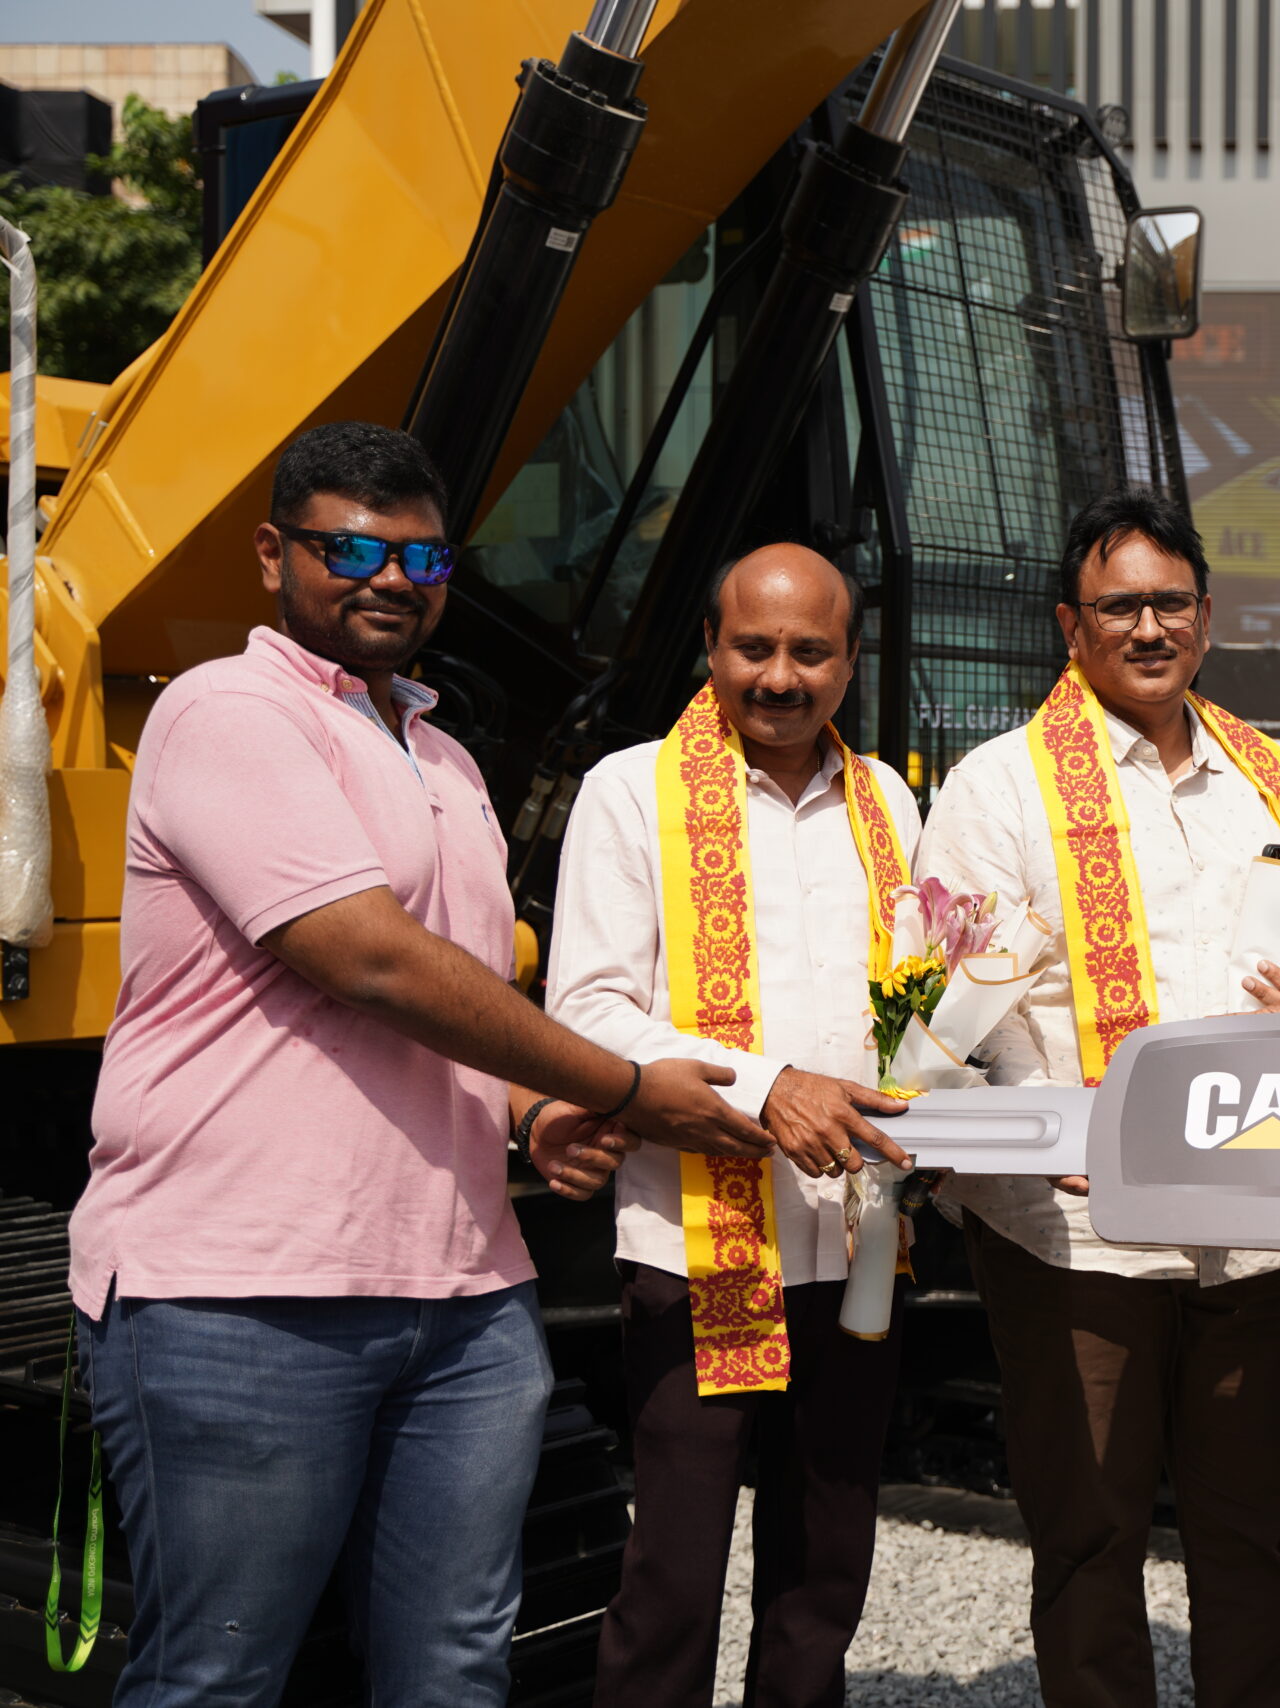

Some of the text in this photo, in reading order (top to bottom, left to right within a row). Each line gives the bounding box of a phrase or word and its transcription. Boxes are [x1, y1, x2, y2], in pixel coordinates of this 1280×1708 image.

[88, 1507, 100, 1597] bauma CONEXPO INDIA
